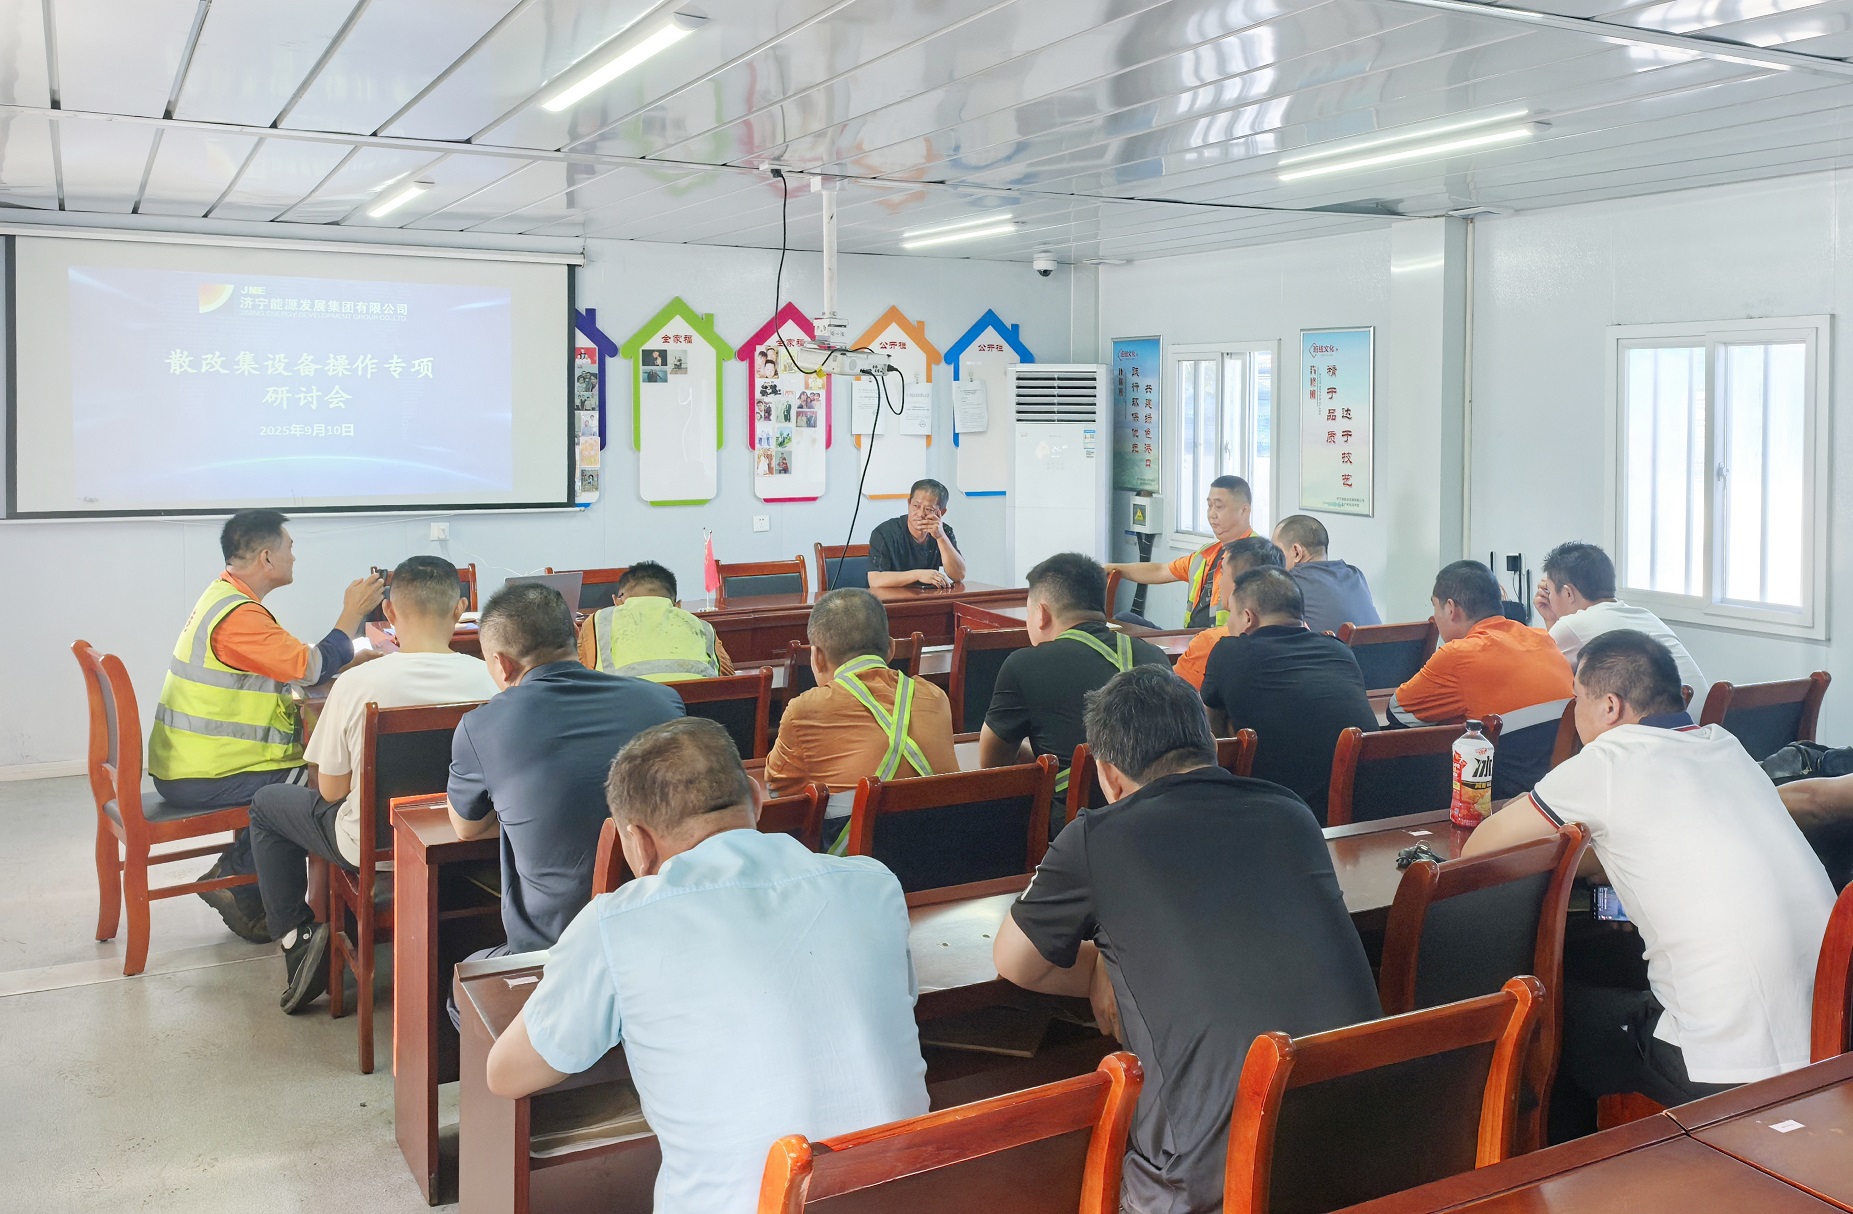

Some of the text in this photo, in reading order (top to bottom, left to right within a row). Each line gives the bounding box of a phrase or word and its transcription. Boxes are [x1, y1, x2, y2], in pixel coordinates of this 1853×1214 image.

[240, 297, 408, 316] 济宁能源发展集团有限公司
[661, 334, 693, 344] 全家福
[164, 348, 434, 379] 散改集设备操作专项
[261, 385, 352, 411] 研讨会
[1326, 364, 1337, 444] 精于品质
[259, 423, 354, 437] 2025年9月10日
[1341, 407, 1353, 488] 达于技艺
